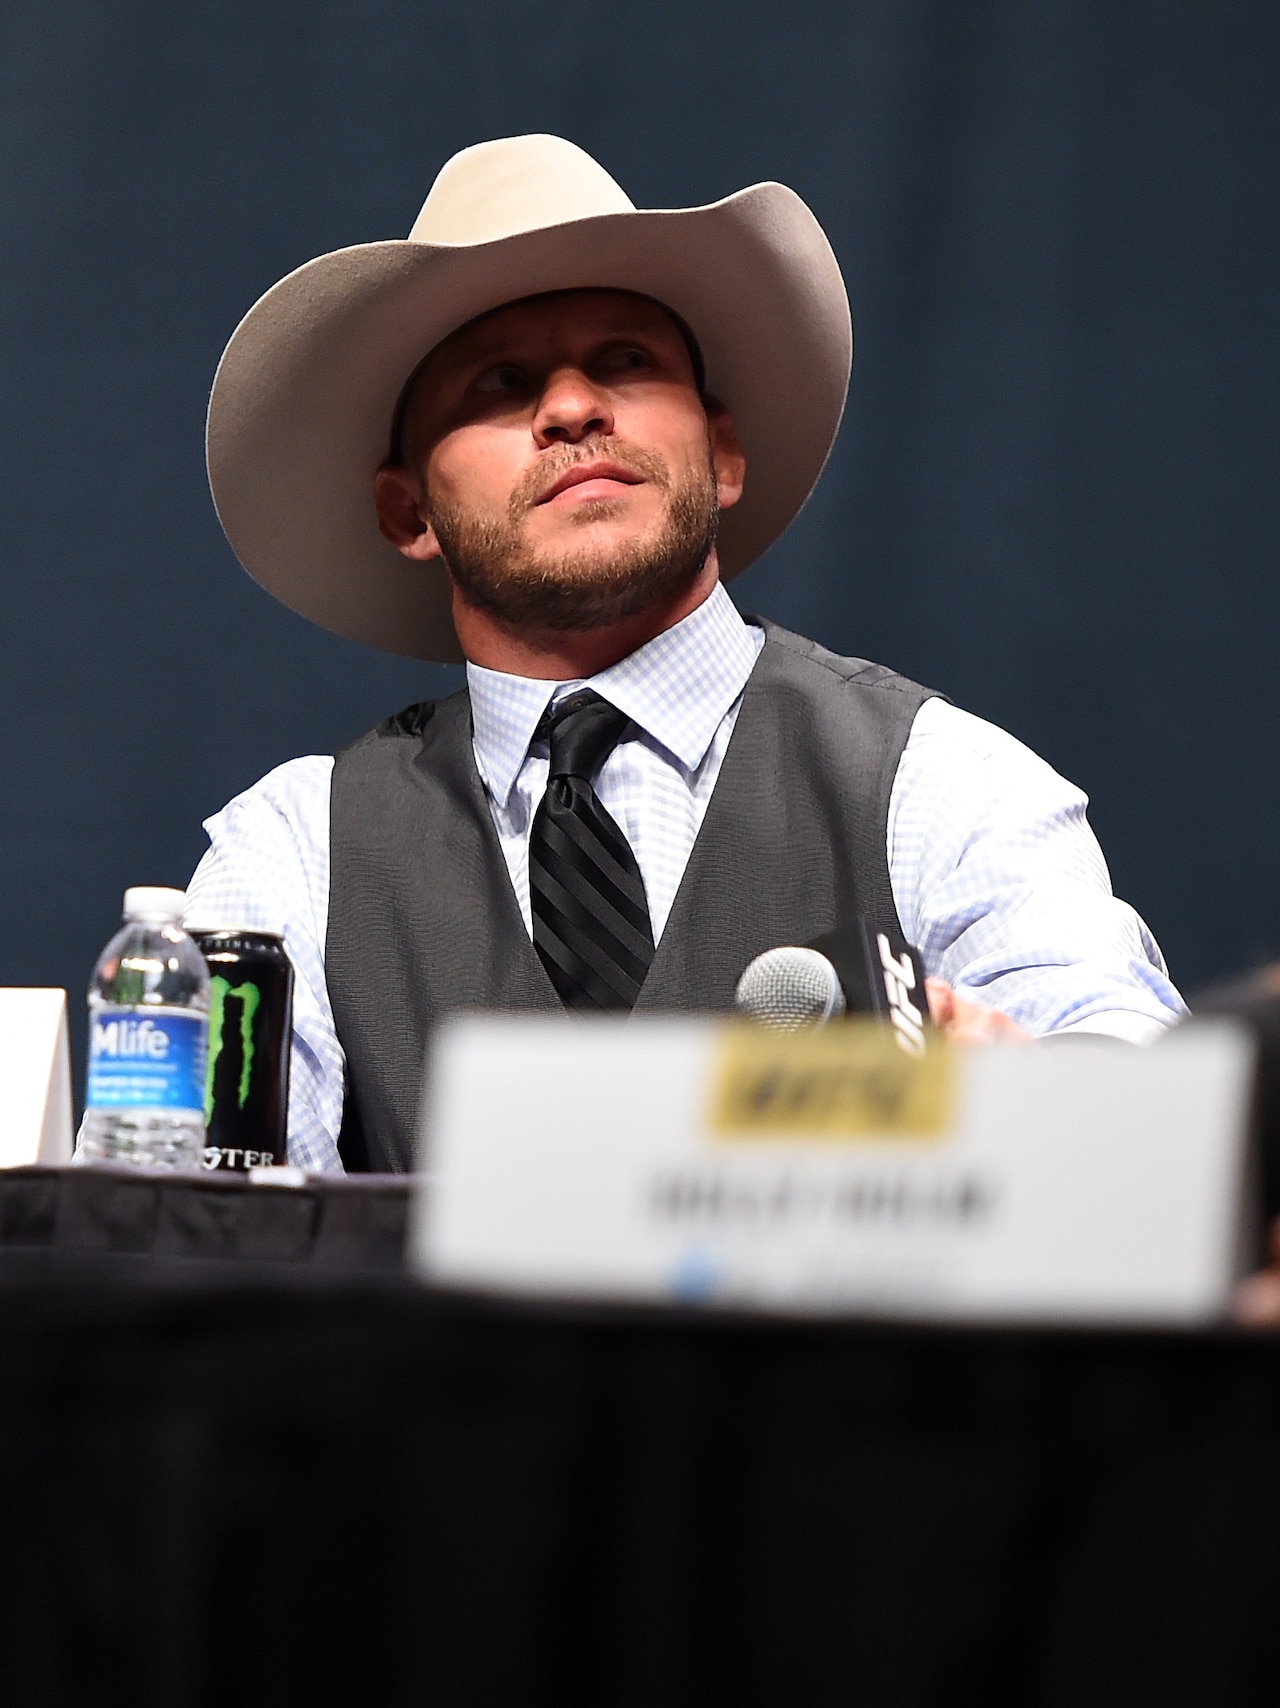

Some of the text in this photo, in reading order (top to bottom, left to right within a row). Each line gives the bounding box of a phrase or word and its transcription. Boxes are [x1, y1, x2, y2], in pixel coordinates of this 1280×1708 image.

[877, 932, 926, 1057] UFC
[91, 1020, 170, 1058] Mlife
[202, 1146, 275, 1170] STER
